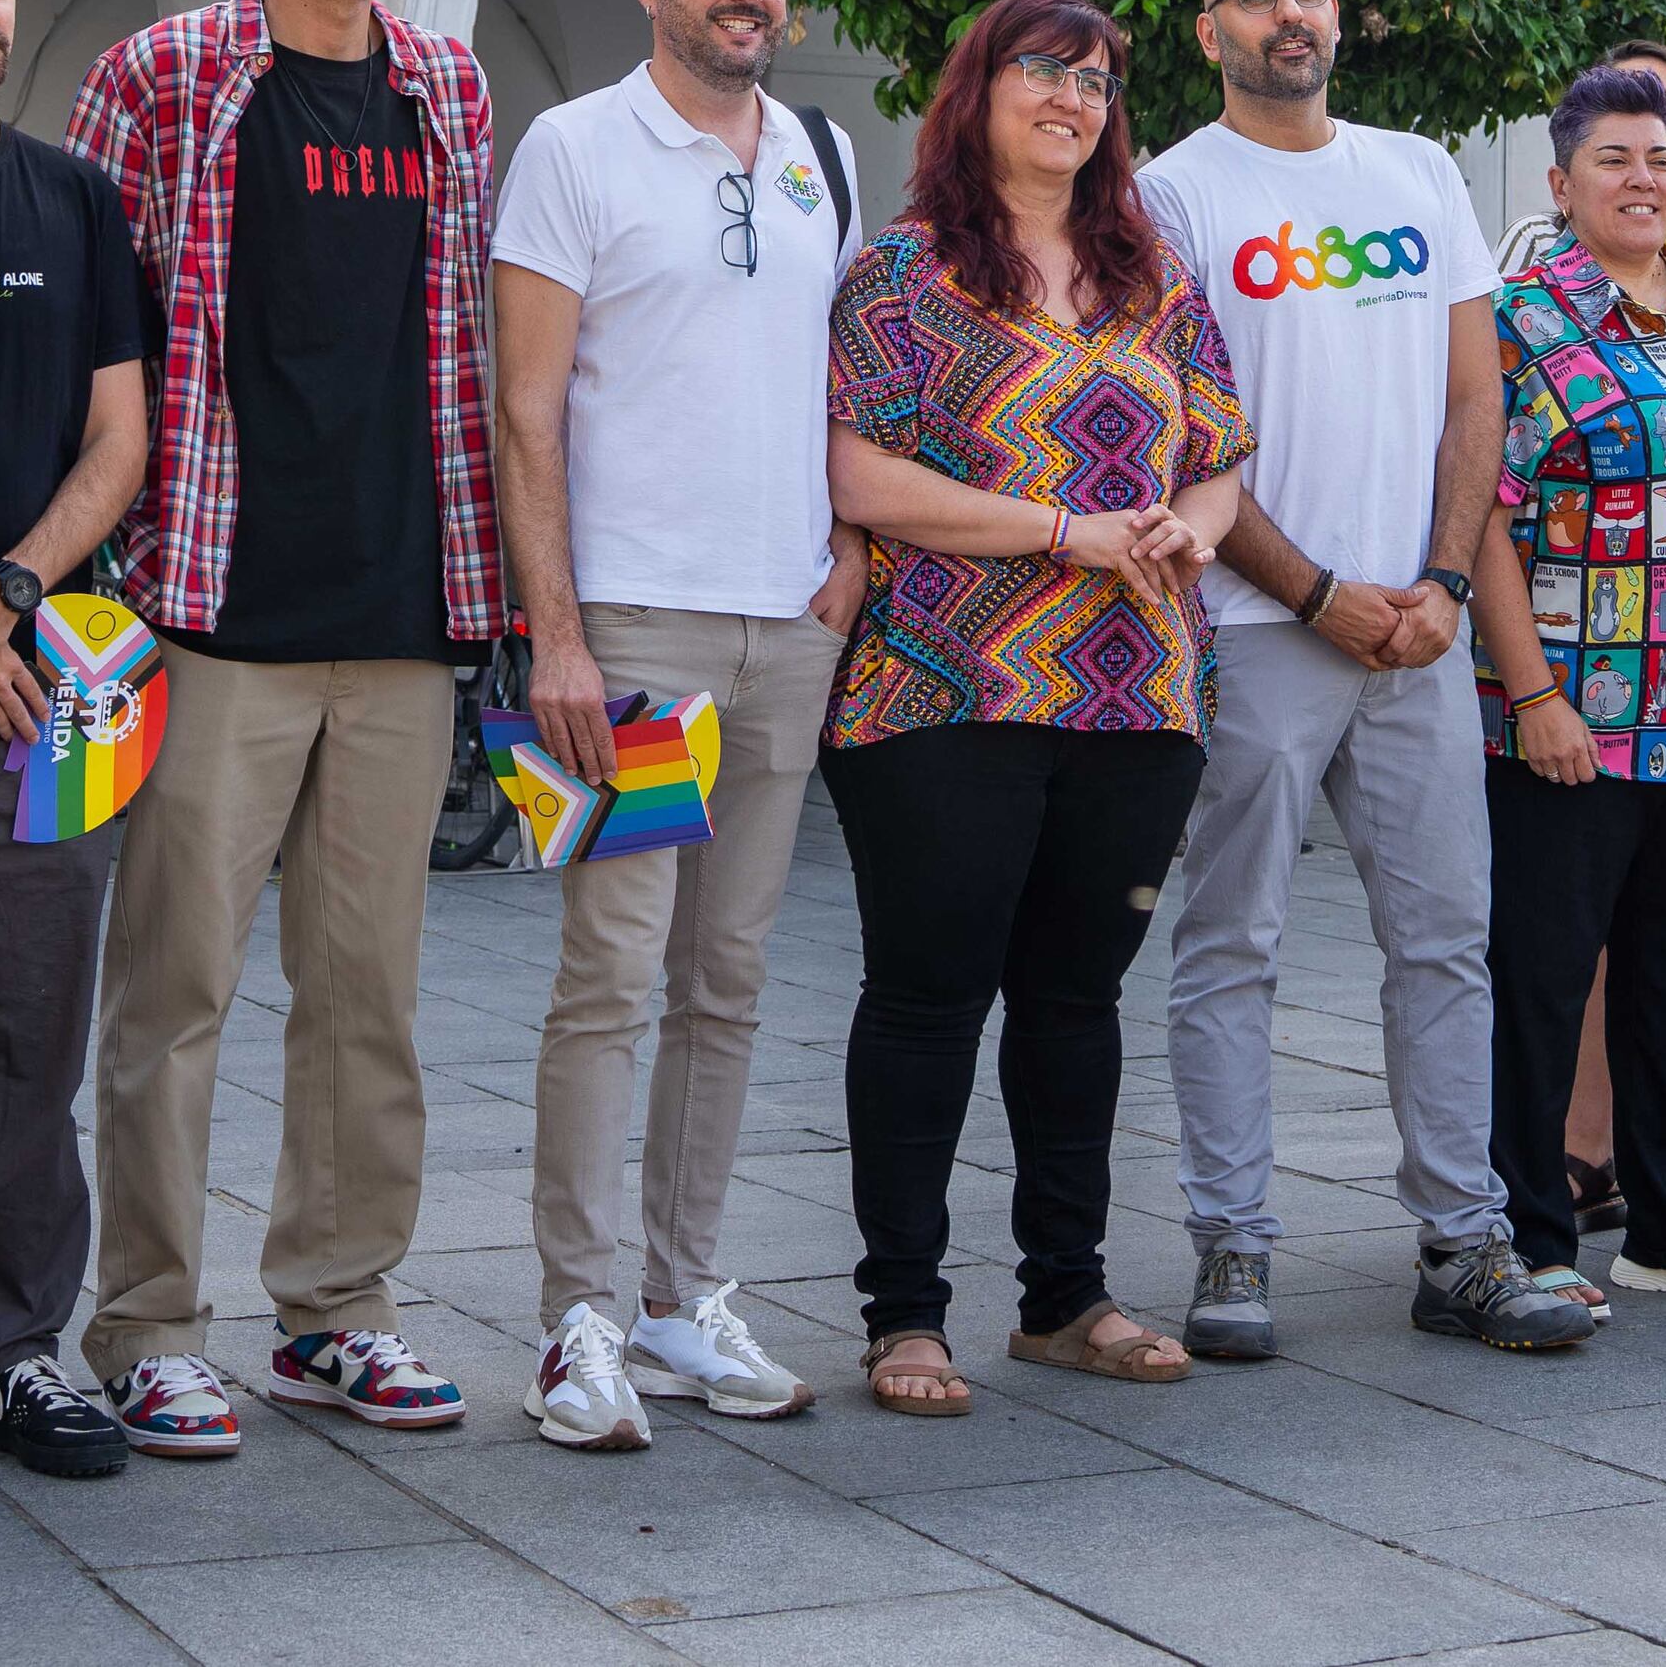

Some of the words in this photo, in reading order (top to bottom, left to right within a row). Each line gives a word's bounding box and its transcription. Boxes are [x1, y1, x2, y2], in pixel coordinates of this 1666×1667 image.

[303, 141, 425, 199] DREAM
[784, 185, 820, 199] CERES
[3, 272, 44, 286] ALONE
[1553, 364, 1572, 381] KITTY
[1590, 445, 1613, 455] HATCH
[1593, 457, 1612, 466] YOUR
[1595, 466, 1629, 477] TROUBLES
[1611, 488, 1631, 498] LITTLE
[1604, 500, 1635, 511] RUNAWAY
[1554, 567, 1579, 579] SCHOOL
[1534, 578, 1556, 589] MOUSE
[1653, 580, 1664, 589] ON
